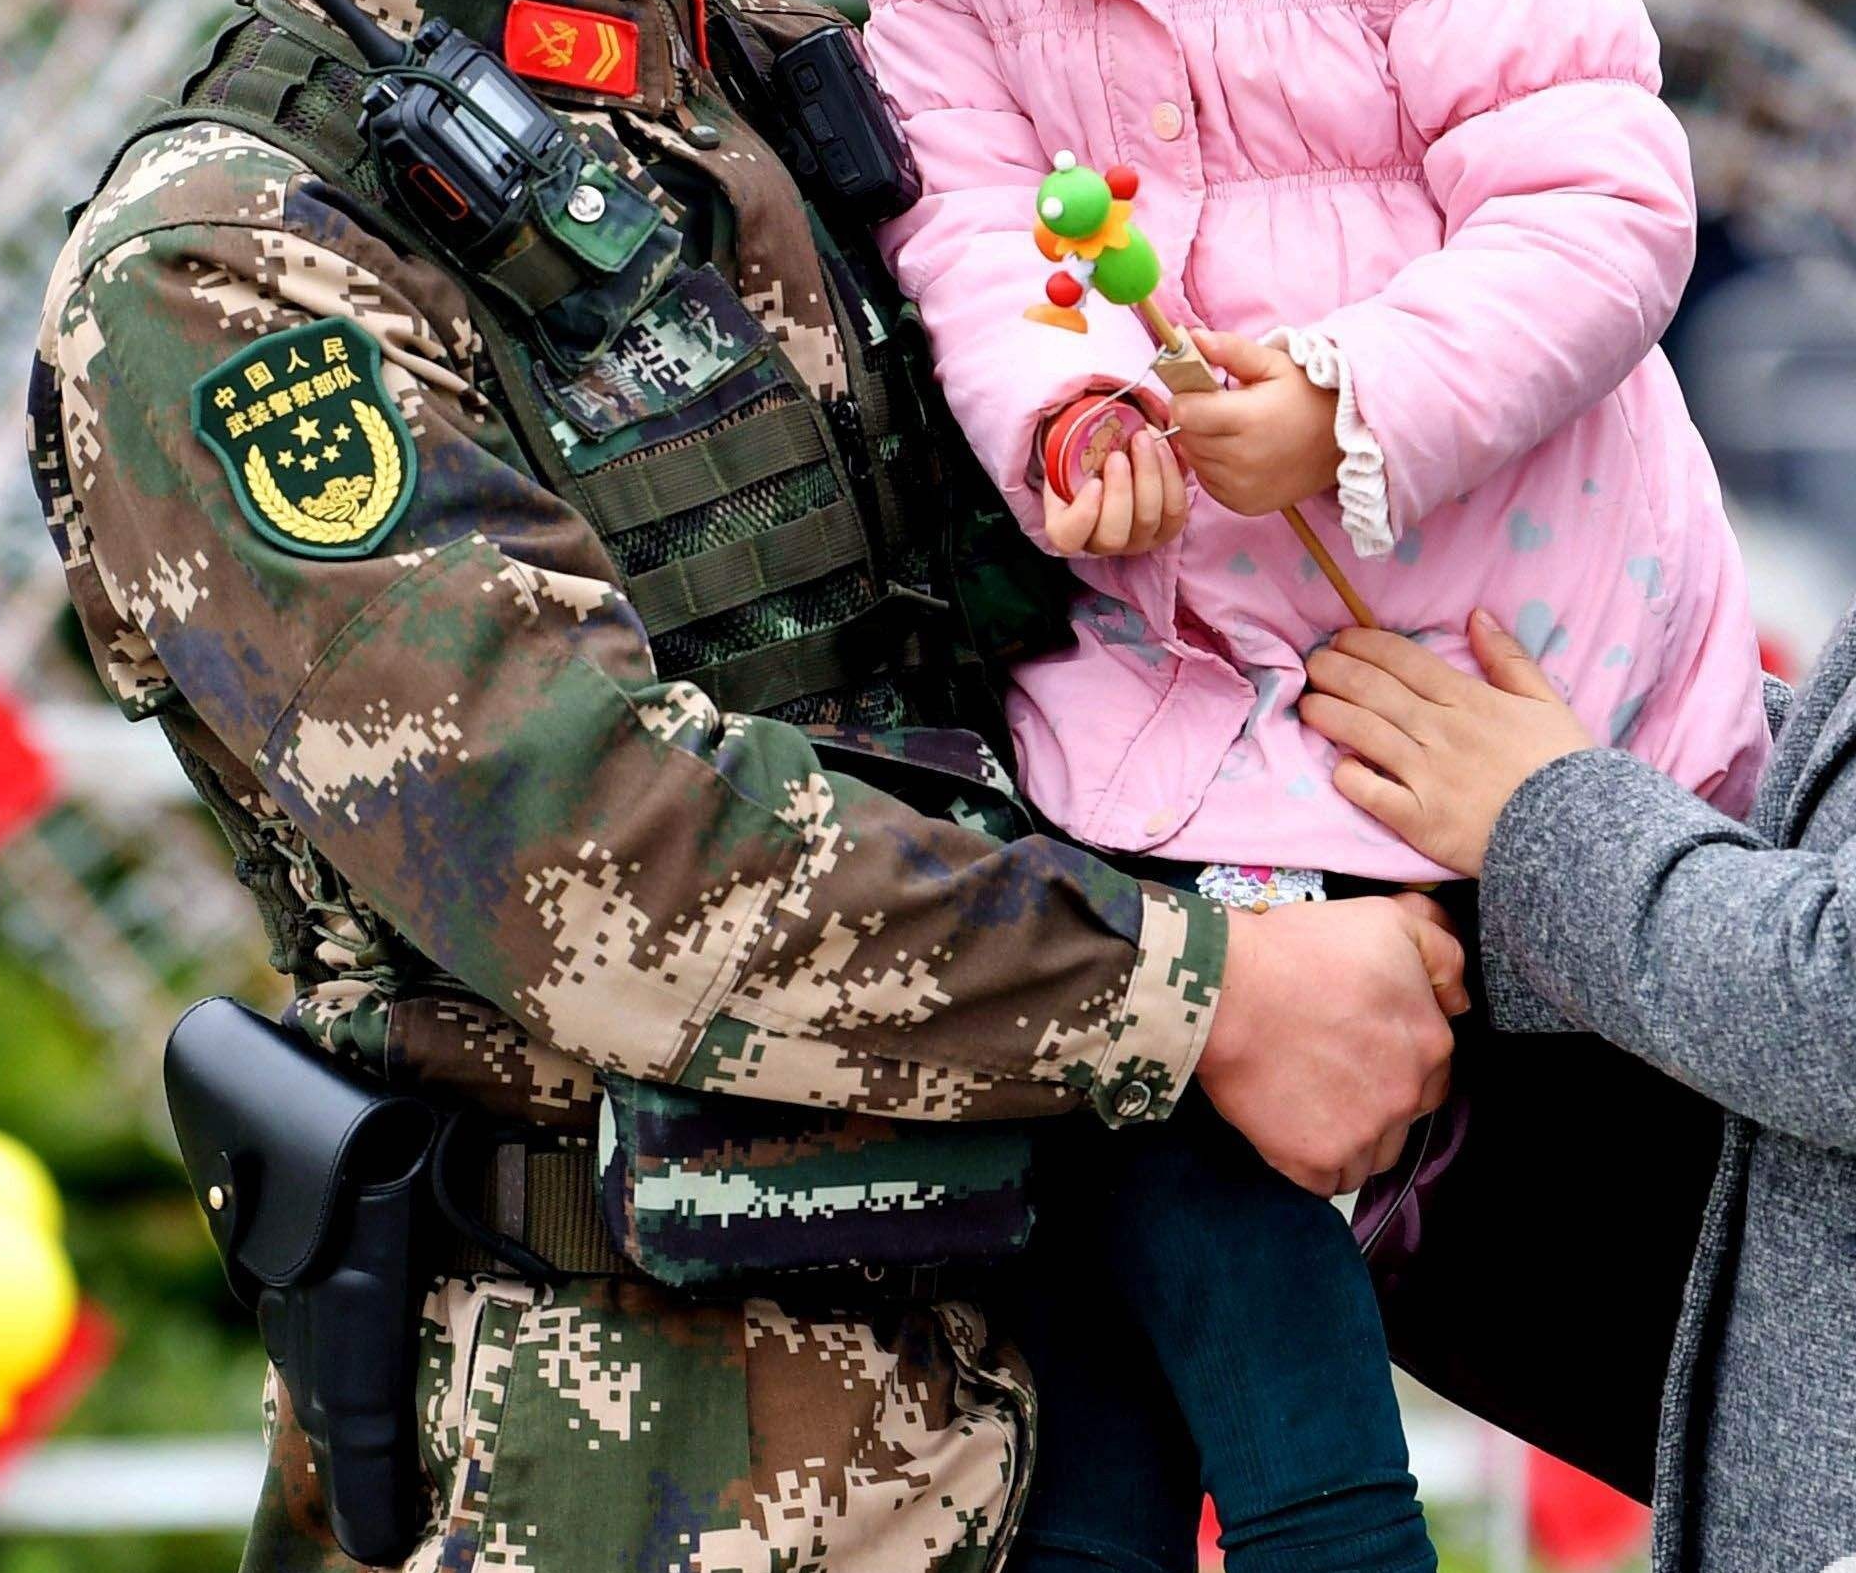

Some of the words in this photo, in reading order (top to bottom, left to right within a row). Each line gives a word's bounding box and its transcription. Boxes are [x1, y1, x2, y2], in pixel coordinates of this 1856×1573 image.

[214, 337, 349, 409] 中国人民
[225, 363, 362, 439] 武装警察部队
